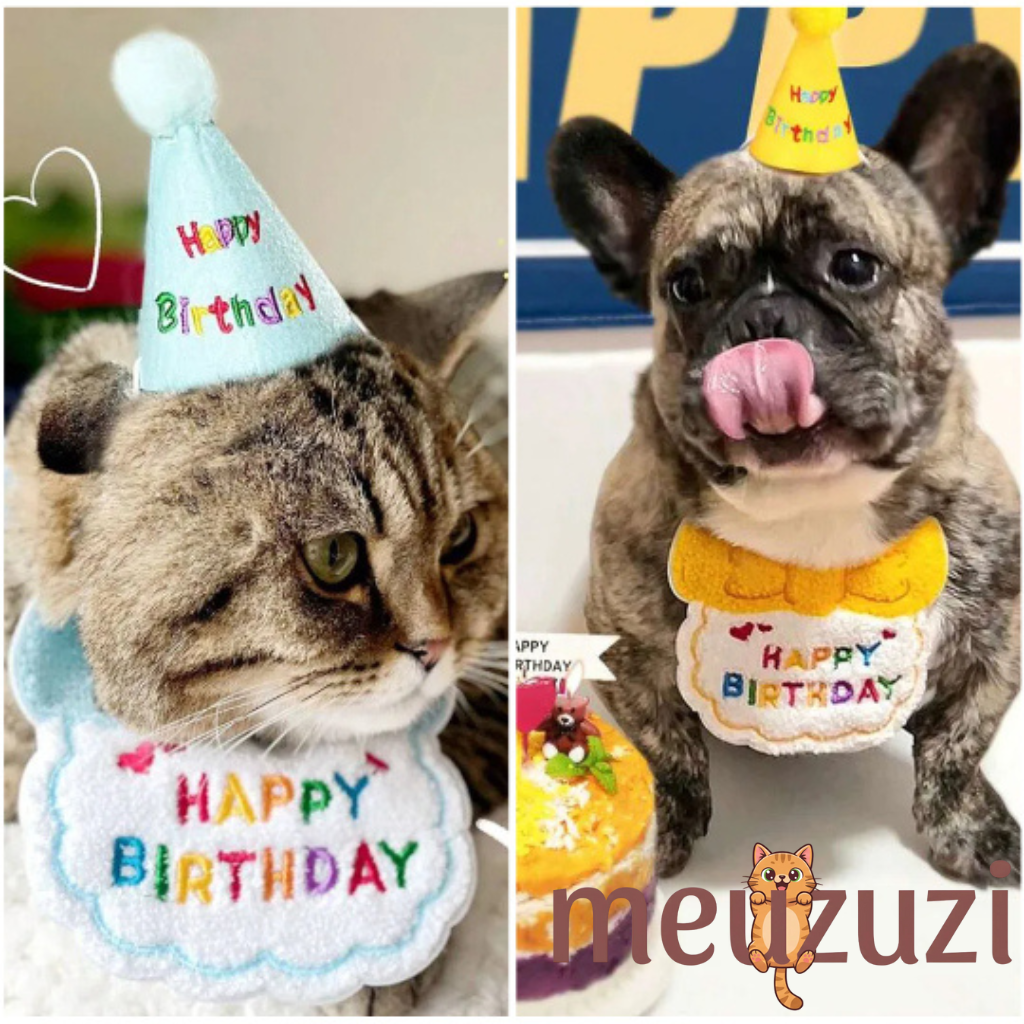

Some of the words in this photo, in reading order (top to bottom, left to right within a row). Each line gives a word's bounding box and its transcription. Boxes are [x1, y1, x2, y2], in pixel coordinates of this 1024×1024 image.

[790, 85, 838, 104] Happy
[765, 105, 852, 143] Birthday
[176, 210, 261, 258] Happy
[155, 274, 316, 334] Birthday
[762, 641, 882, 670] HAPPY
[722, 671, 902, 709] BIRTHDAY
[176, 772, 369, 825] HAPPY
[110, 836, 418, 905] BIRTHDAY
